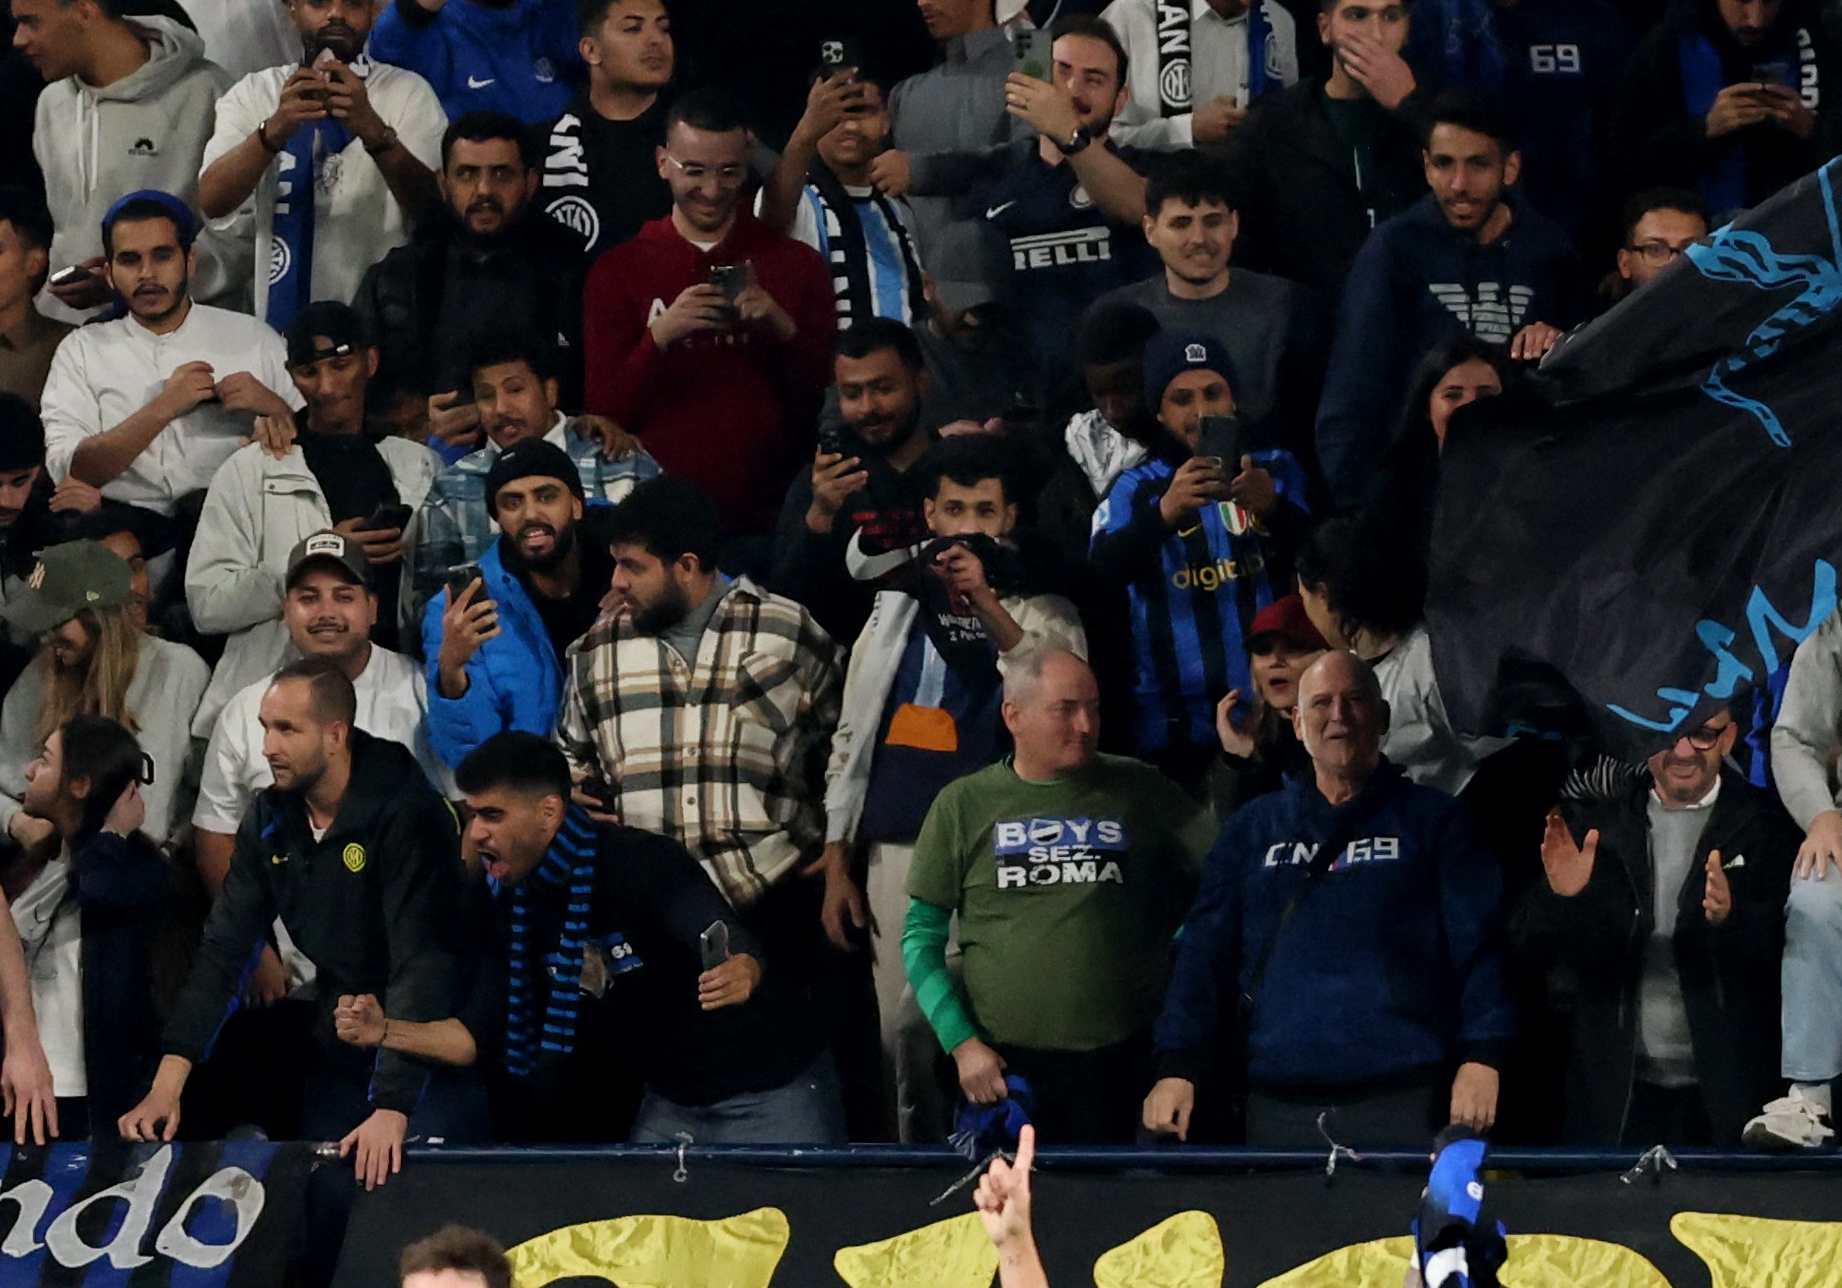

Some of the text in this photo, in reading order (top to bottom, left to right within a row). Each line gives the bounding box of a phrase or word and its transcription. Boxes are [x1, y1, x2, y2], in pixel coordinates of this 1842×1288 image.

[1529, 44, 1581, 73] 69
[995, 817, 1126, 847] BOYS
[995, 862, 1125, 890] ROMA
